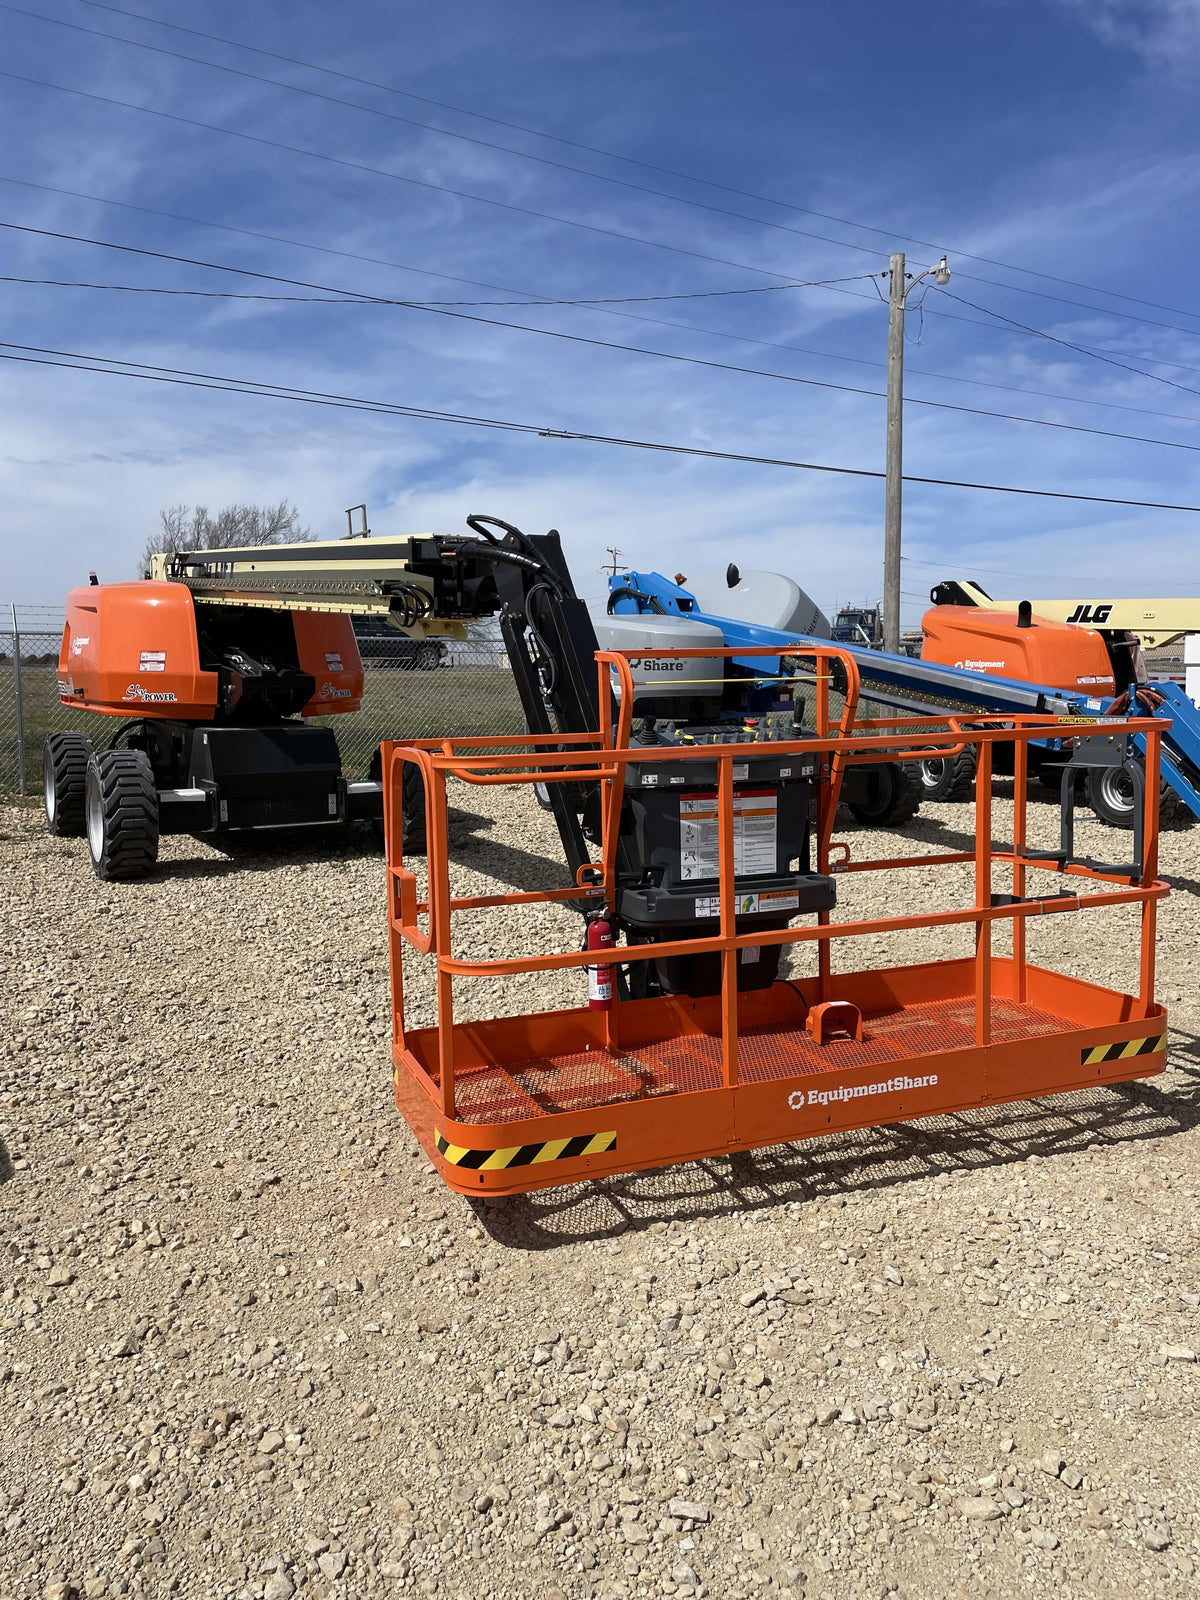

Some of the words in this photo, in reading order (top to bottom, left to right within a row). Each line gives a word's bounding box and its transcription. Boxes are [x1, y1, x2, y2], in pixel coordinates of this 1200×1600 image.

[1065, 604, 1113, 623] JLG
[643, 660, 684, 671] Share
[965, 660, 1005, 669] Equipment
[144, 693, 175, 701] POWER
[807, 1074, 938, 1106] EquipmentShare
